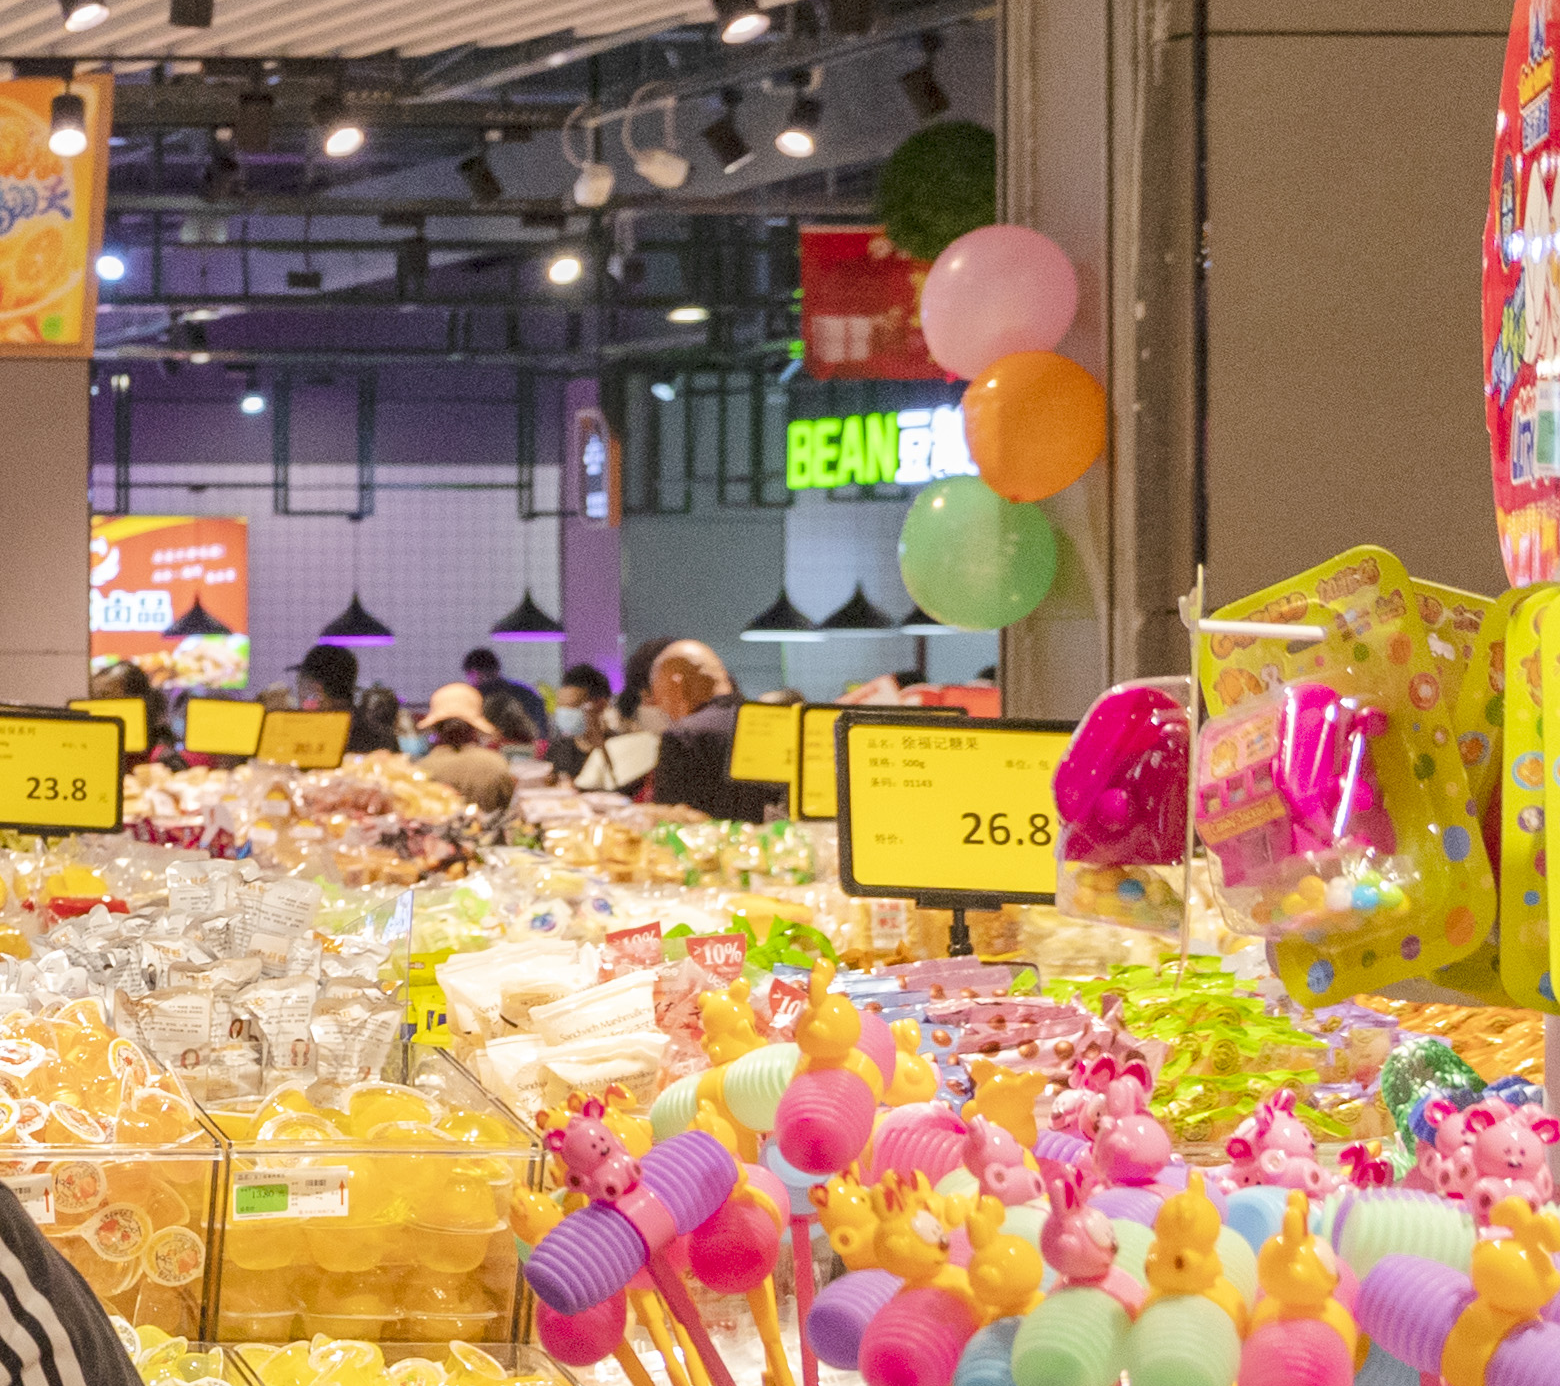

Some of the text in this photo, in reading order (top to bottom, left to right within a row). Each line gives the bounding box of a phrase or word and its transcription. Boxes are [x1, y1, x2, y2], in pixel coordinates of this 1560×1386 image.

[787, 412, 900, 490] BEAN
[901, 736, 980, 752] 徐福记糖果
[26, 776, 88, 802] 23.8
[961, 812, 1053, 847] 26.8
